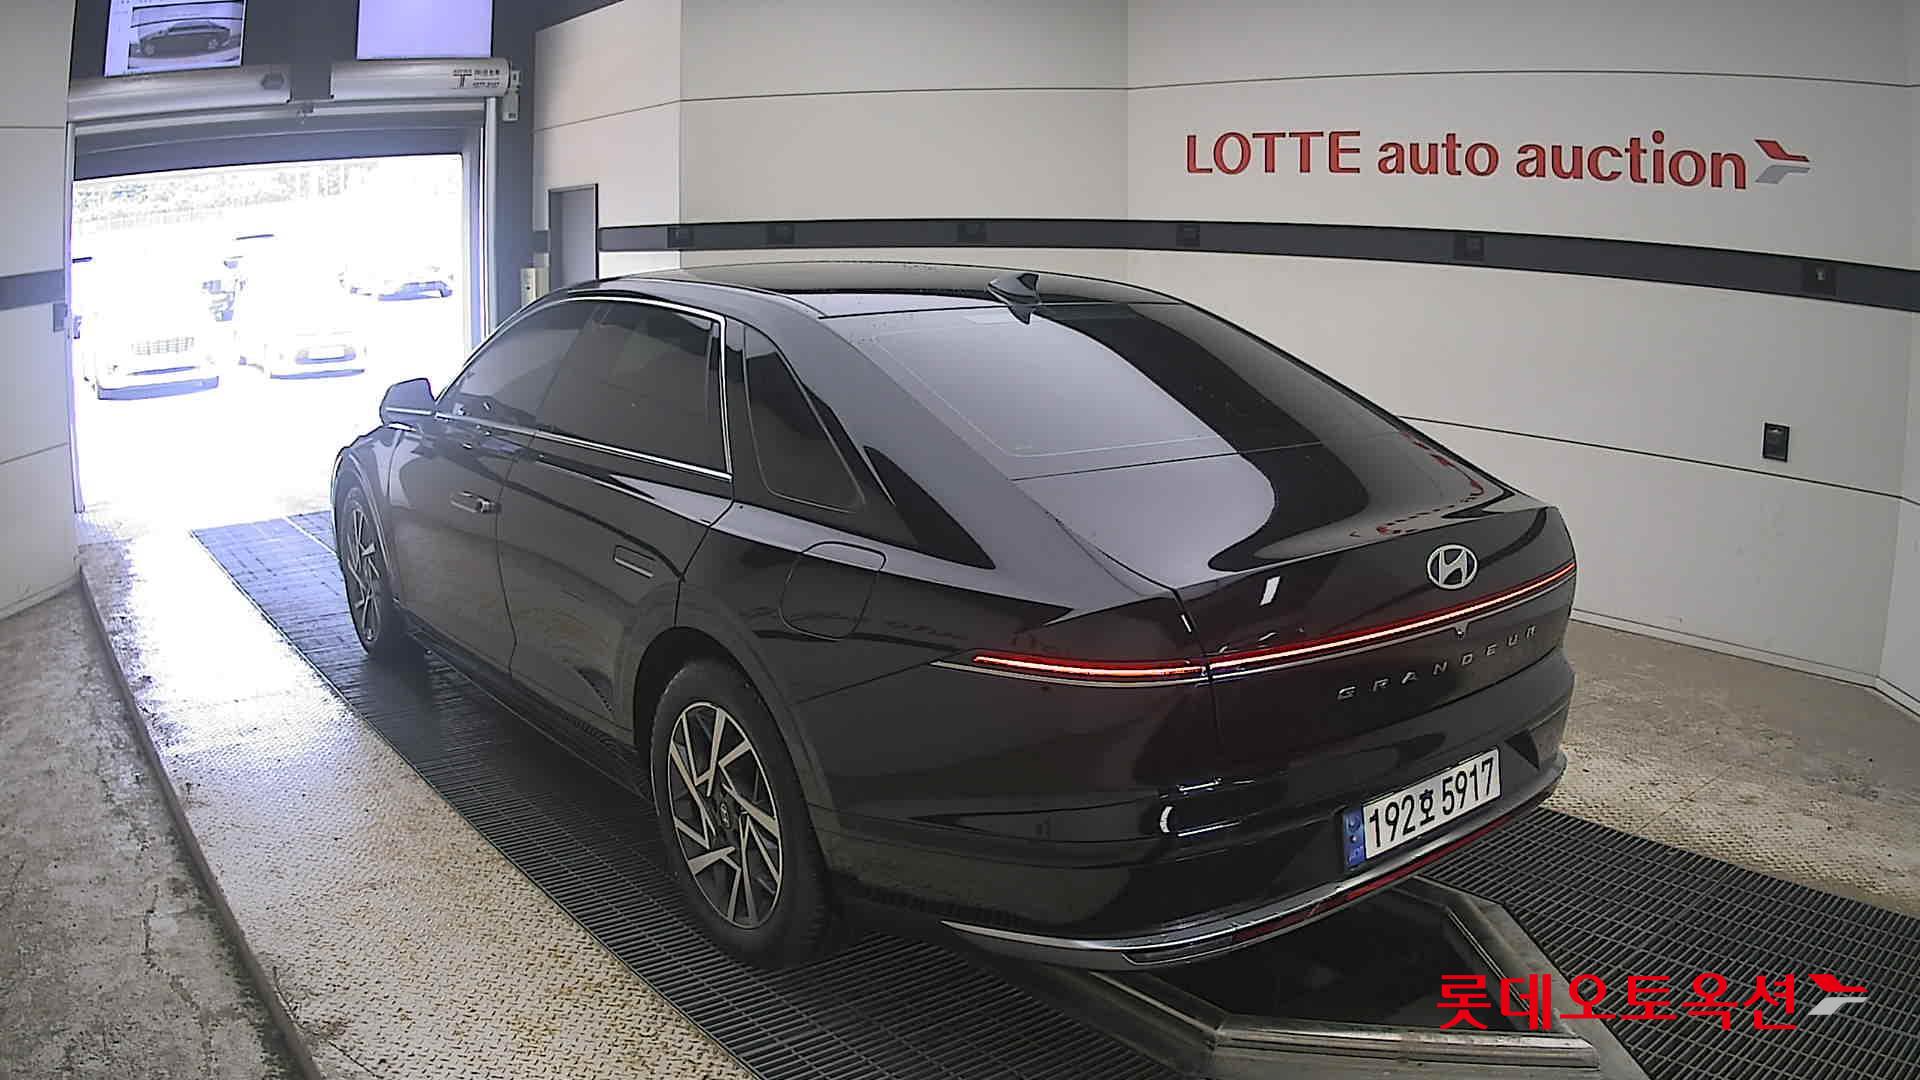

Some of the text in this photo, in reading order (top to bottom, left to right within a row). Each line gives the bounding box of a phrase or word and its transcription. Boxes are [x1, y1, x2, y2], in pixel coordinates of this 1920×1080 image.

[1186, 130, 1747, 189] LOTTE auto auction
[1337, 624, 1537, 701] GRANDEUR
[1368, 756, 1494, 848] 192호 5917
